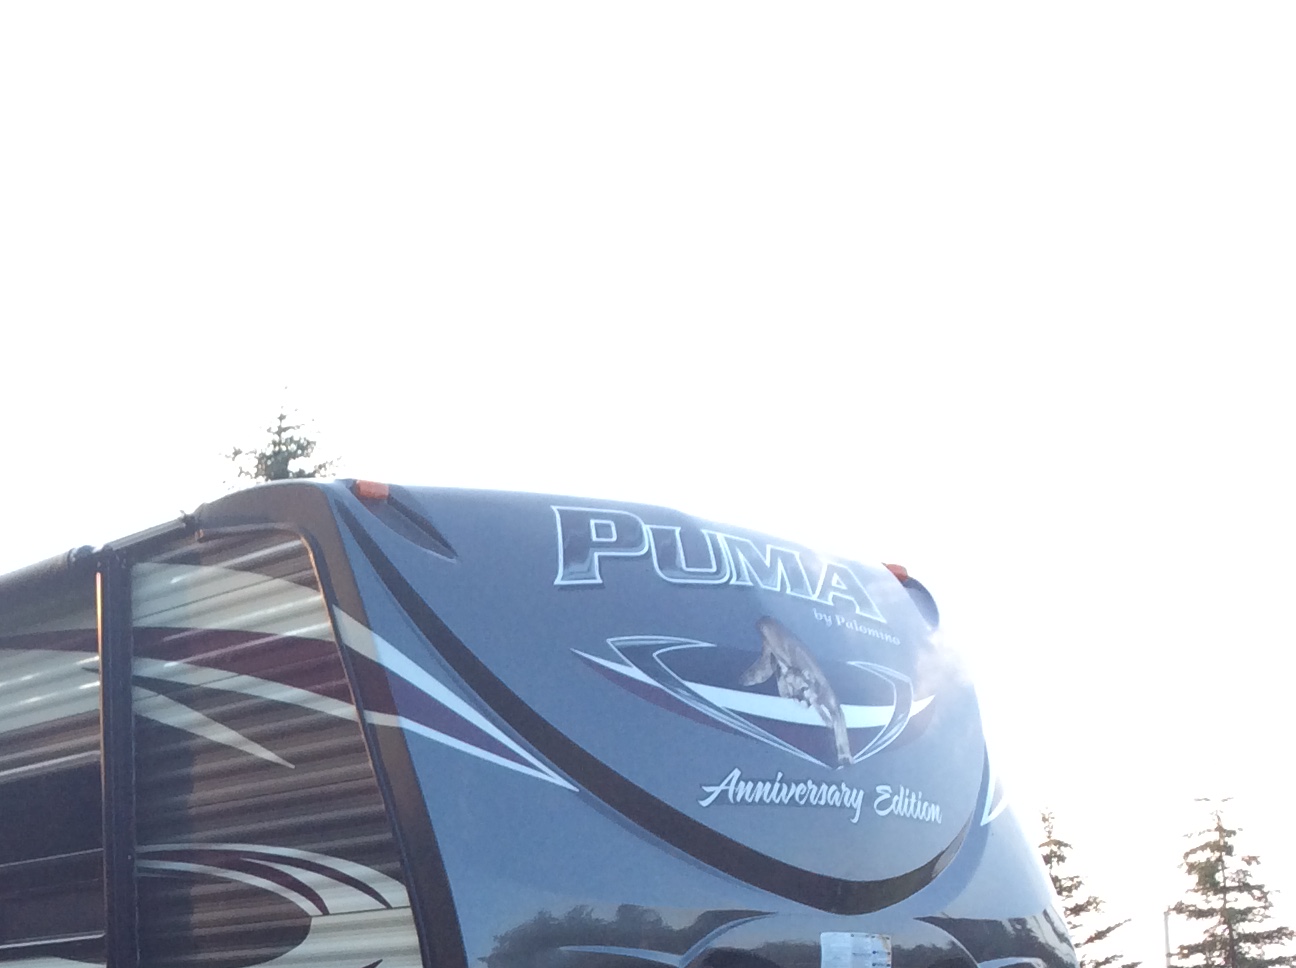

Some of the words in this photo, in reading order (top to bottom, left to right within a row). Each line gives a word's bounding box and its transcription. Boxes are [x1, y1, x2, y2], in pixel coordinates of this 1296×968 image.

[551, 504, 888, 623] PUMA
[813, 608, 832, 627] by
[836, 614, 901, 645] Palomino
[698, 767, 864, 823] Anniversary
[874, 785, 943, 824] Edition
